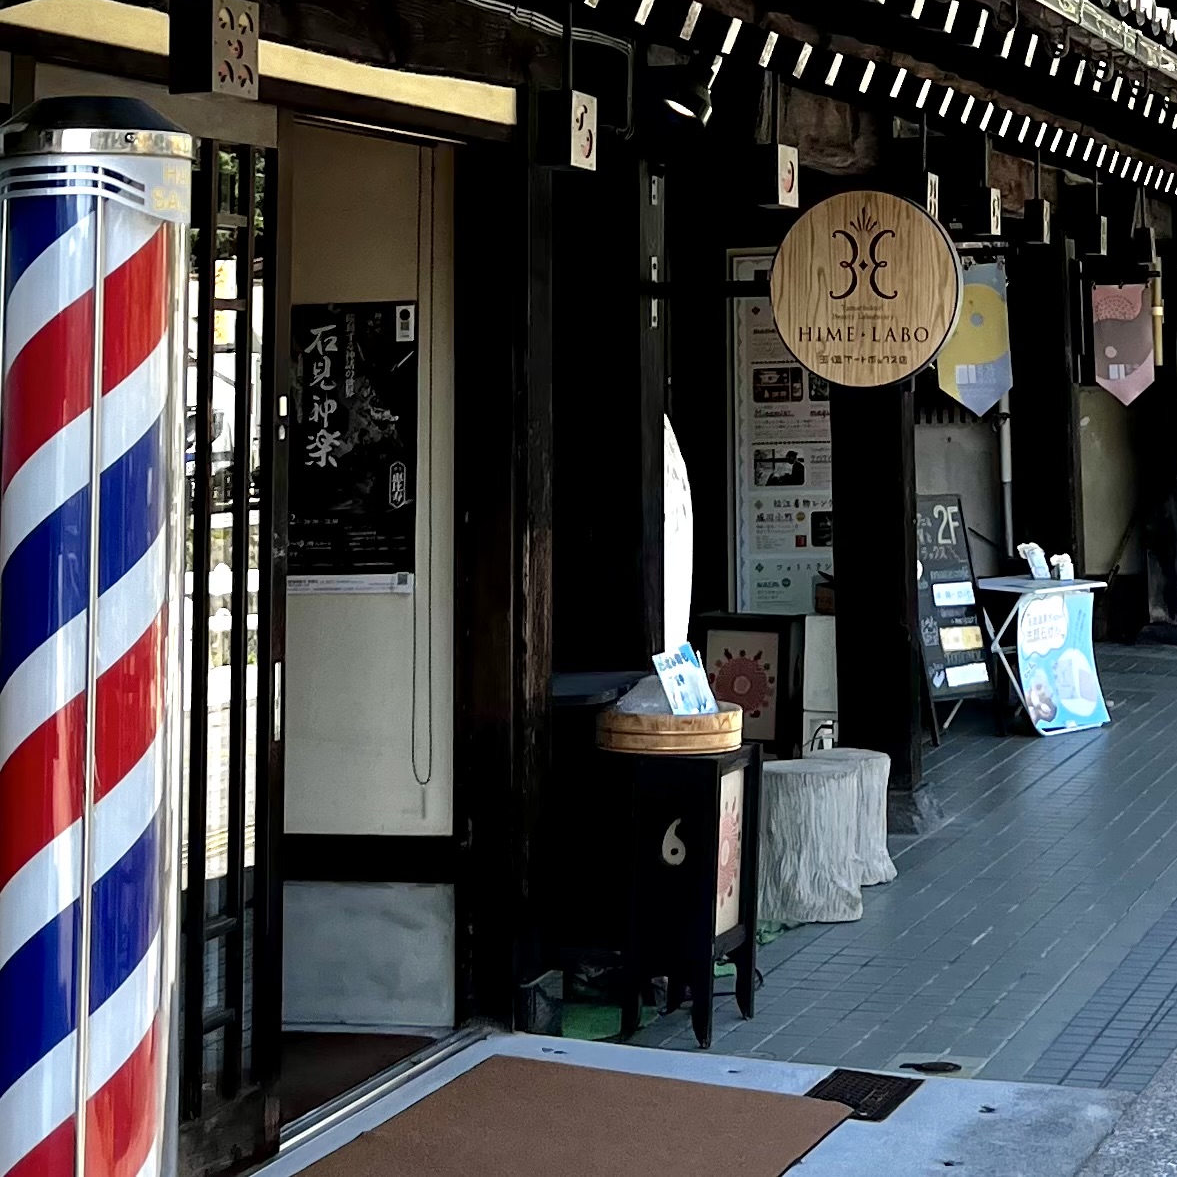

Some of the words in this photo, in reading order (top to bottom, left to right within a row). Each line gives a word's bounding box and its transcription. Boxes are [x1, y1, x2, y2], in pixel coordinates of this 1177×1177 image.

[304, 324, 341, 468] 石見神楽
[933, 504, 960, 545] 2F
